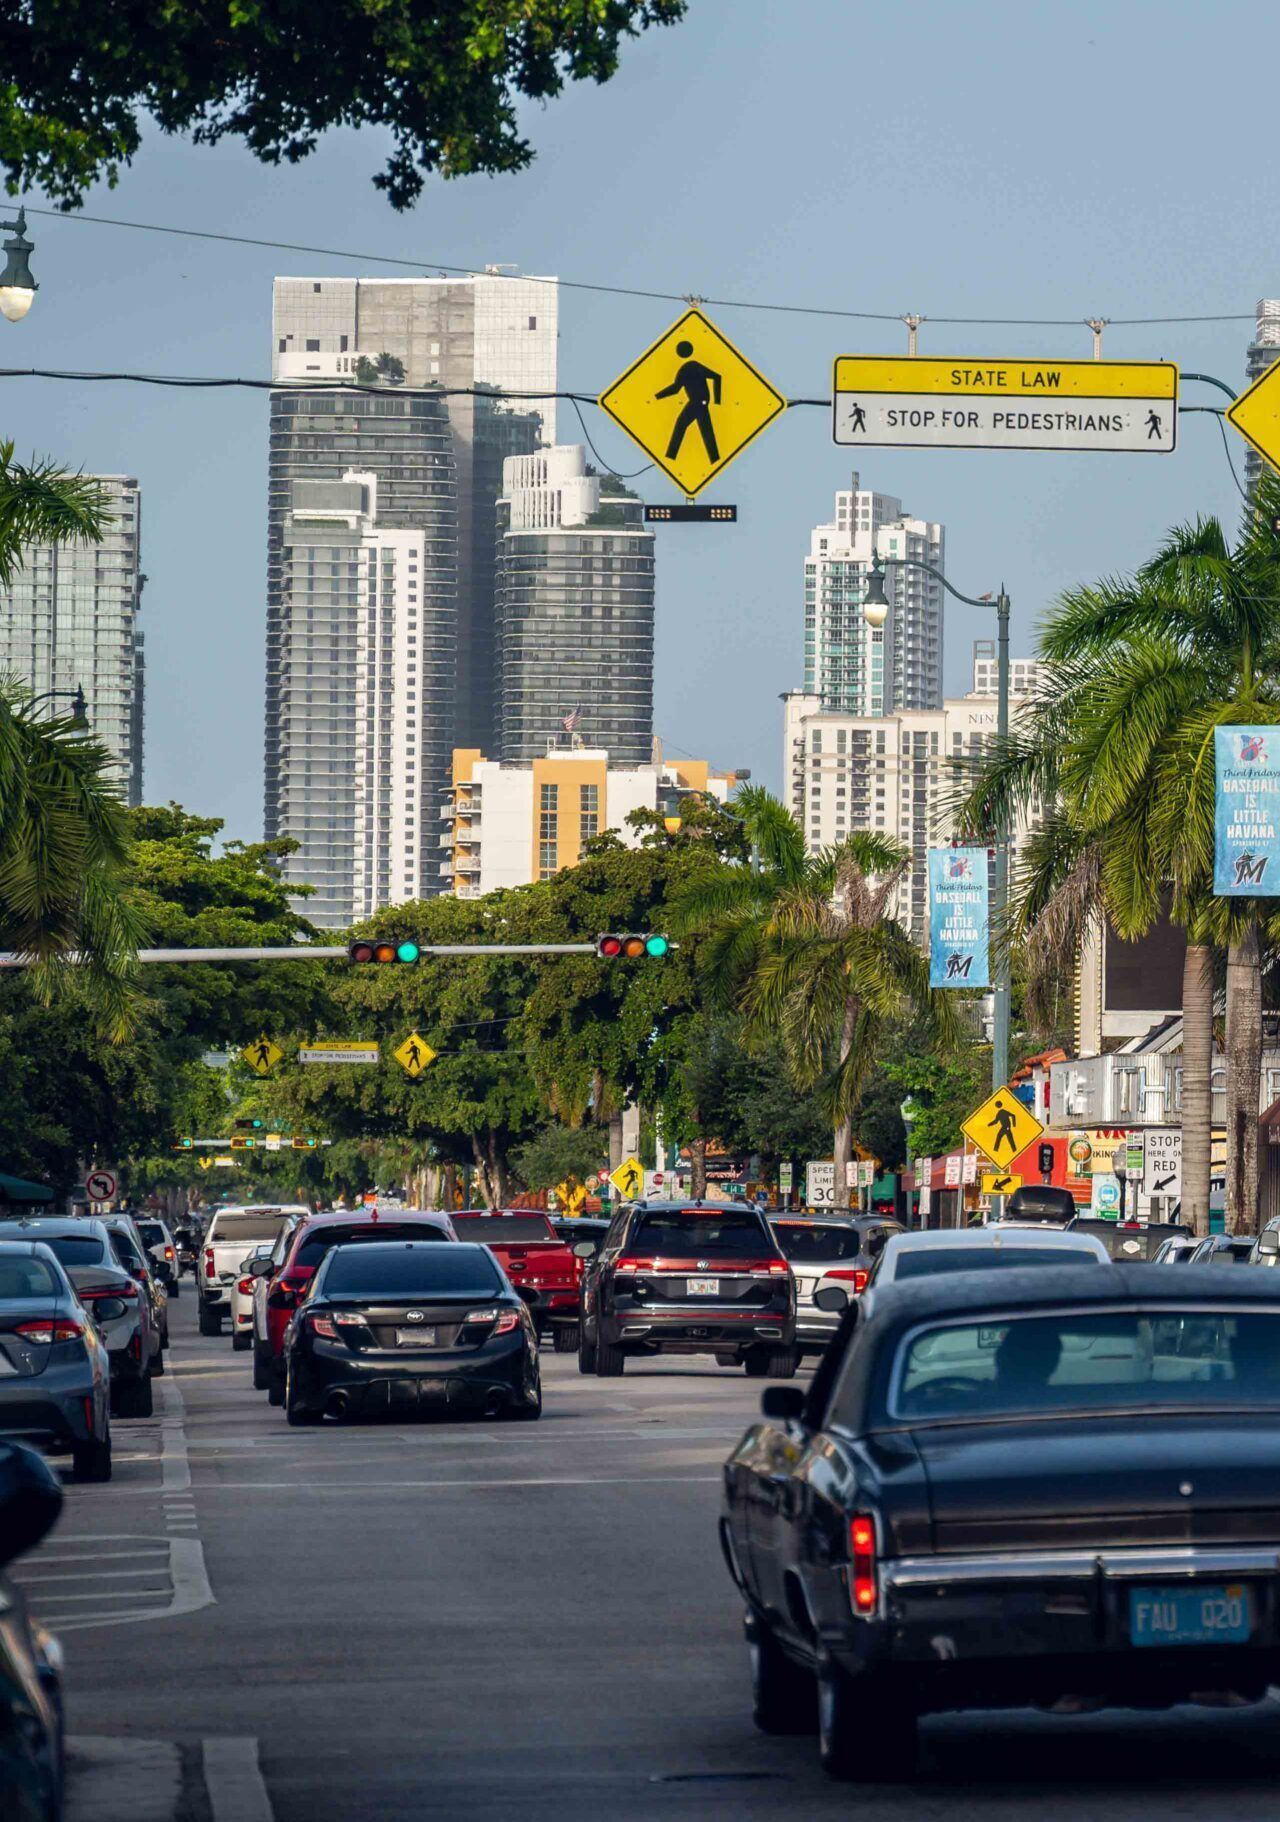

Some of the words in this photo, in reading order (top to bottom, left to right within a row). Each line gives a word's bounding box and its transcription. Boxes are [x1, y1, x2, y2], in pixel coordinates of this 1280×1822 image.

[951, 370, 1007, 387] STATE
[1021, 372, 1061, 388] LAW
[887, 410, 935, 427] STOP
[942, 411, 979, 428] FOR
[992, 412, 1123, 432] PEDESTRIANS
[968, 713, 998, 725] NIN
[1222, 779, 1280, 793] BASEBALL
[1245, 794, 1257, 807] IS
[1233, 810, 1268, 824] LITTLE
[1226, 825, 1275, 839] HAVANA
[935, 892, 981, 904] BASEBALL
[945, 916, 973, 929] LITTLE
[939, 928, 979, 941] HAVANA
[1150, 1136, 1181, 1146] STOP
[812, 1166, 834, 1174] SPEE
[1153, 1160, 1177, 1171] RED
